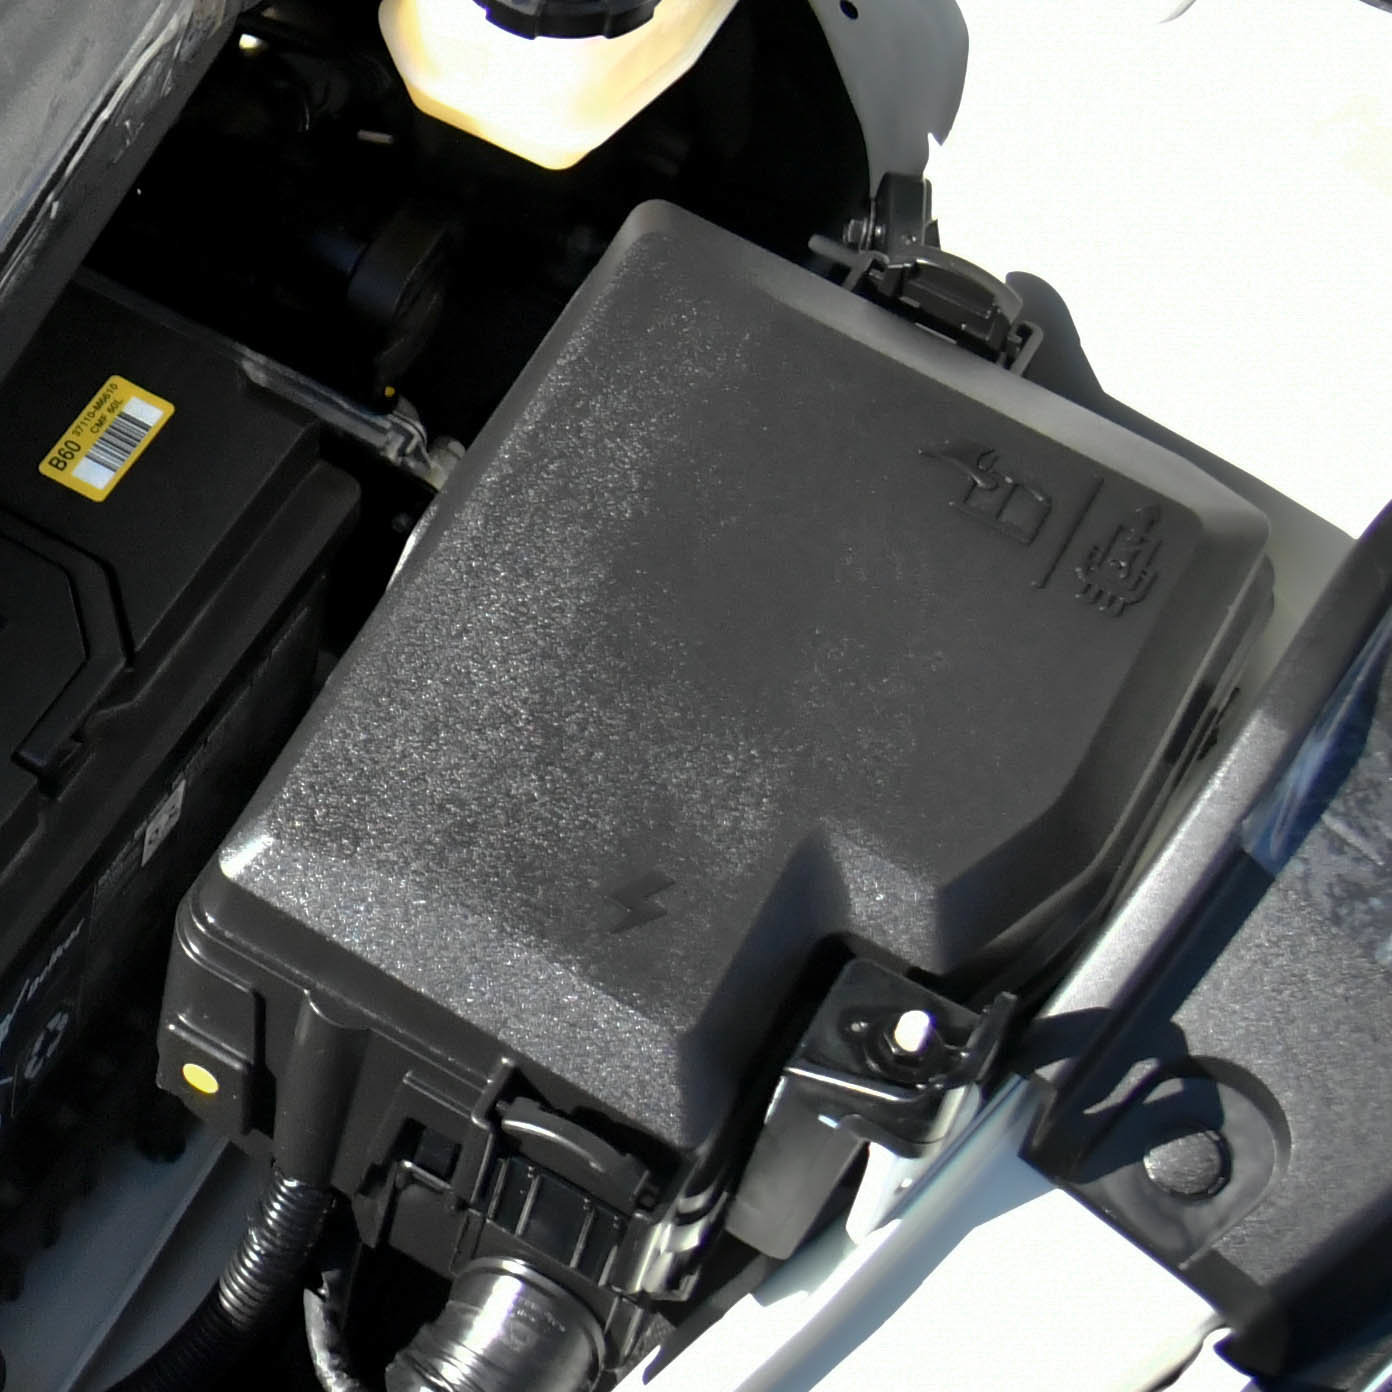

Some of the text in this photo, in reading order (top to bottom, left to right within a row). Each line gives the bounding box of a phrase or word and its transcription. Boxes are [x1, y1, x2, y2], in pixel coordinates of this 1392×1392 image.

[48, 383, 118, 471] B60 37110-M6610
[90, 414, 106, 435] CMF
